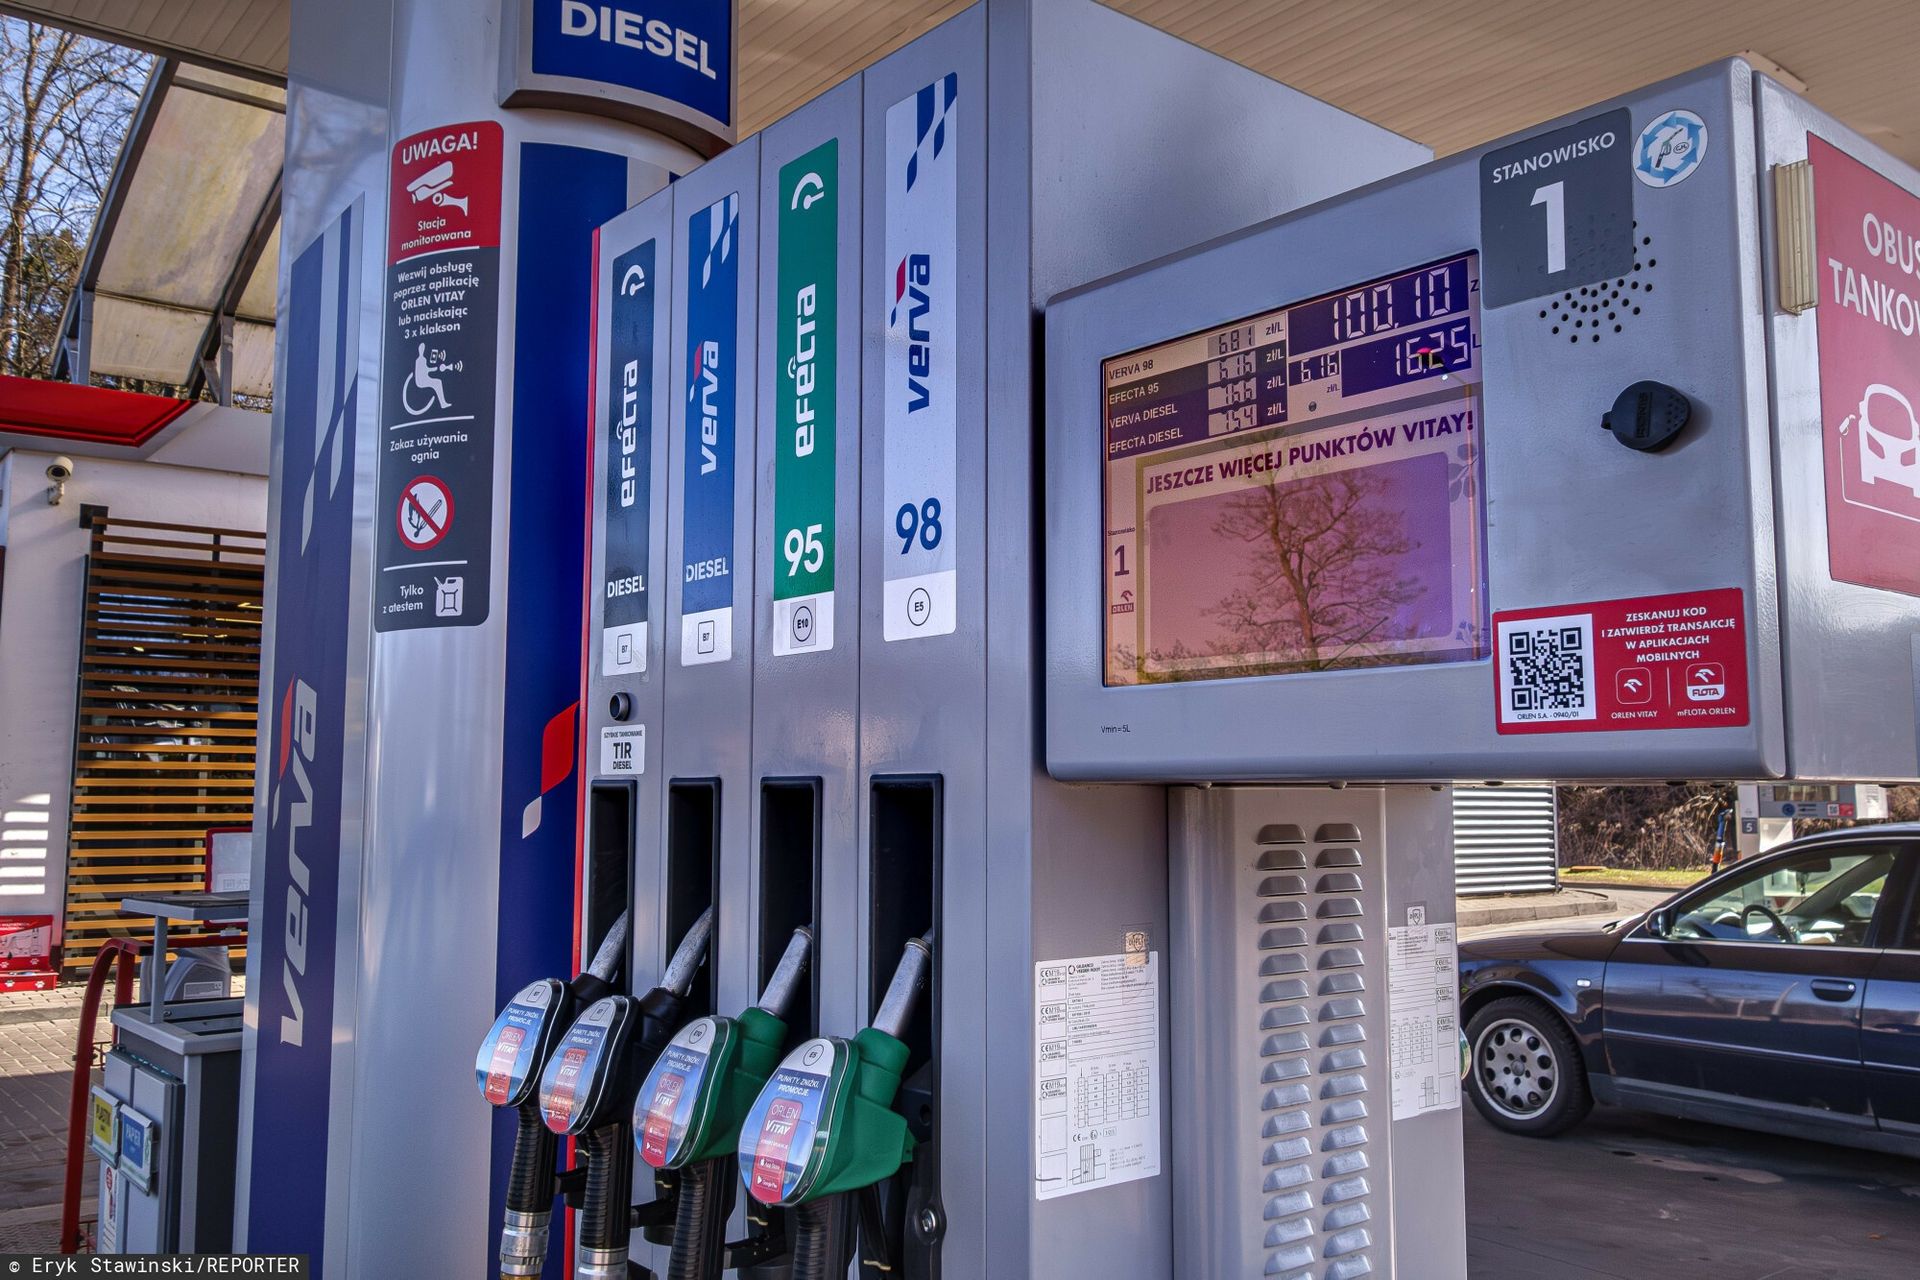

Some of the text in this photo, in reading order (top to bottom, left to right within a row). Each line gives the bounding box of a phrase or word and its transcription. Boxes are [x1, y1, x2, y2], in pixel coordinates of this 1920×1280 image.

[561, 0, 716, 80] DIESEL
[402, 132, 478, 165] UWAGA!
[1492, 130, 1616, 184] STANOWISKO
[418, 217, 446, 232] Stacja
[1530, 180, 1566, 274] 1
[401, 229, 471, 251] monitorowana
[398, 261, 473, 283] Wezwij obsługę
[393, 275, 479, 301] poprzez aplikację
[1828, 256, 1920, 337] TANKO
[401, 290, 465, 311] ORLEN VITAY
[398, 305, 468, 327] lub naciskając
[404, 322, 461, 339] 3 x klakson
[1109, 366, 1140, 380] VERVA
[1142, 359, 1154, 371] 98
[1266, 322, 1284, 336] zł/L
[1109, 388, 1145, 405] EFECTA
[1147, 382, 1159, 393] 95
[1266, 349, 1284, 362] zł/L
[1109, 413, 1141, 429] VERVA
[1143, 404, 1178, 419] DIESEL
[1266, 376, 1285, 389] zł/L
[1109, 437, 1146, 454] EFECTA
[1148, 428, 1183, 444] DIESEL
[1267, 402, 1285, 416] zł/L
[390, 431, 468, 452] Zakaz używania
[1147, 410, 1474, 494] JESZCZE WIĘCEJ PUNKTÓW VITAY!
[411, 449, 440, 463] ognia
[895, 497, 943, 555] 98
[783, 523, 824, 577] 95
[1115, 544, 1130, 576] 1
[685, 557, 729, 583] DIESEL
[400, 584, 424, 598] Tylko
[607, 575, 645, 598] DIESEL
[382, 601, 424, 614] z atestem
[914, 601, 924, 612] E5
[1113, 603, 1133, 613] ORLEN
[1626, 606, 1707, 622] ZESKANUJ KOD
[796, 617, 809, 629] E10
[1601, 618, 1736, 638] I ZATWIERDŹ TRANSAKCJĘ
[1625, 635, 1710, 651] W APLIKACJACH
[1636, 650, 1700, 663] MOBILNYCH
[1692, 688, 1720, 697] FLOTA
[1611, 710, 1658, 719] ORLEN VITAY
[1677, 707, 1736, 717] mFLOTA ORLEN
[613, 742, 632, 759] TIR
[613, 760, 632, 770] DIESEL
[1746, 822, 1753, 832] 5
[771, 1104, 799, 1120] ORLEN
[765, 1120, 794, 1135] VITAY
